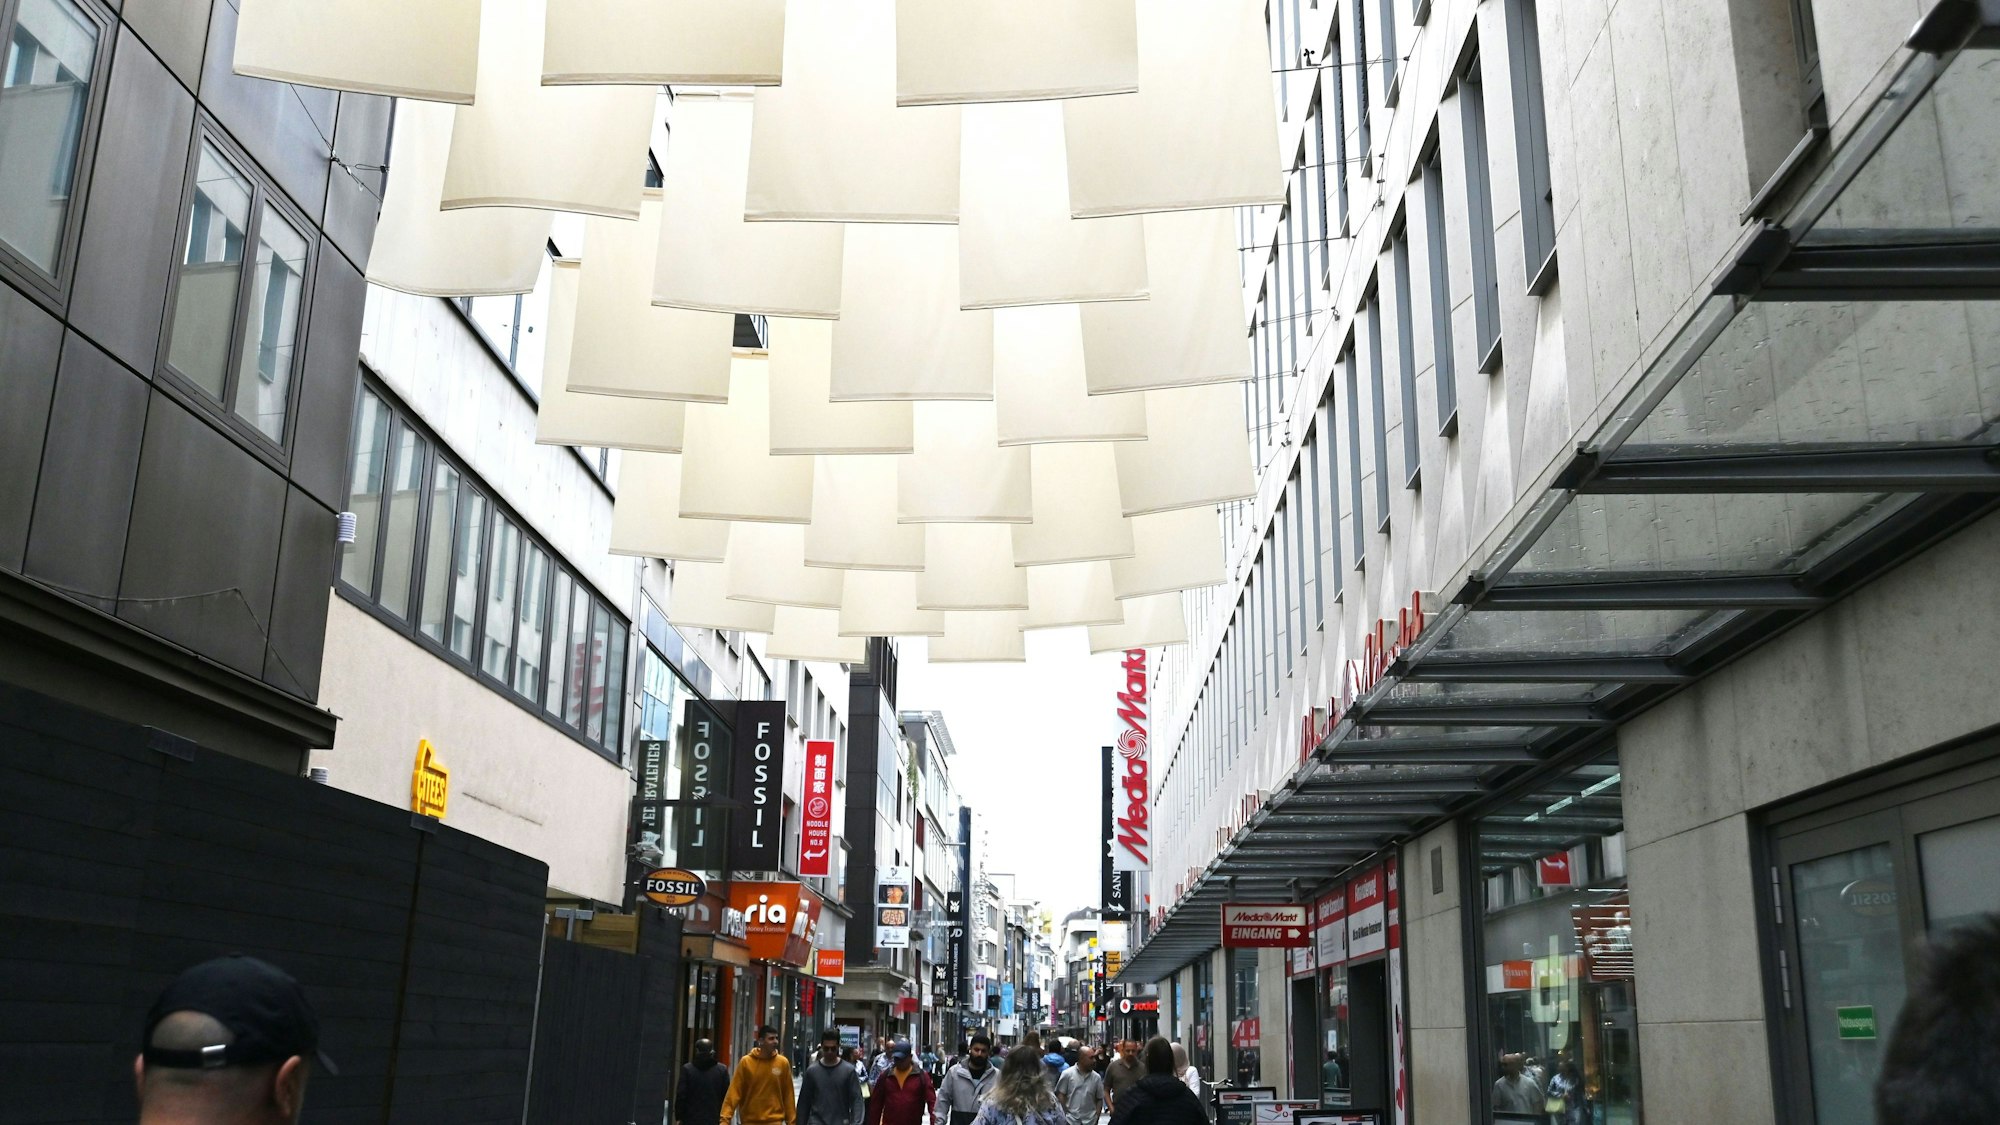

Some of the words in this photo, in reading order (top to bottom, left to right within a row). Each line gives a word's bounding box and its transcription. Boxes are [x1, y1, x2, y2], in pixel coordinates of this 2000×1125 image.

[751, 721, 771, 848] FOSSIL
[1117, 758, 1148, 865] Media
[806, 820, 828, 828] NOODLE
[646, 879, 698, 895] FOSSIL
[744, 894, 787, 924] ria
[1233, 912, 1264, 922] Media
[1270, 912, 1298, 922] Markt
[950, 928, 963, 938] JD
[1231, 927, 1282, 939] EINGANG
